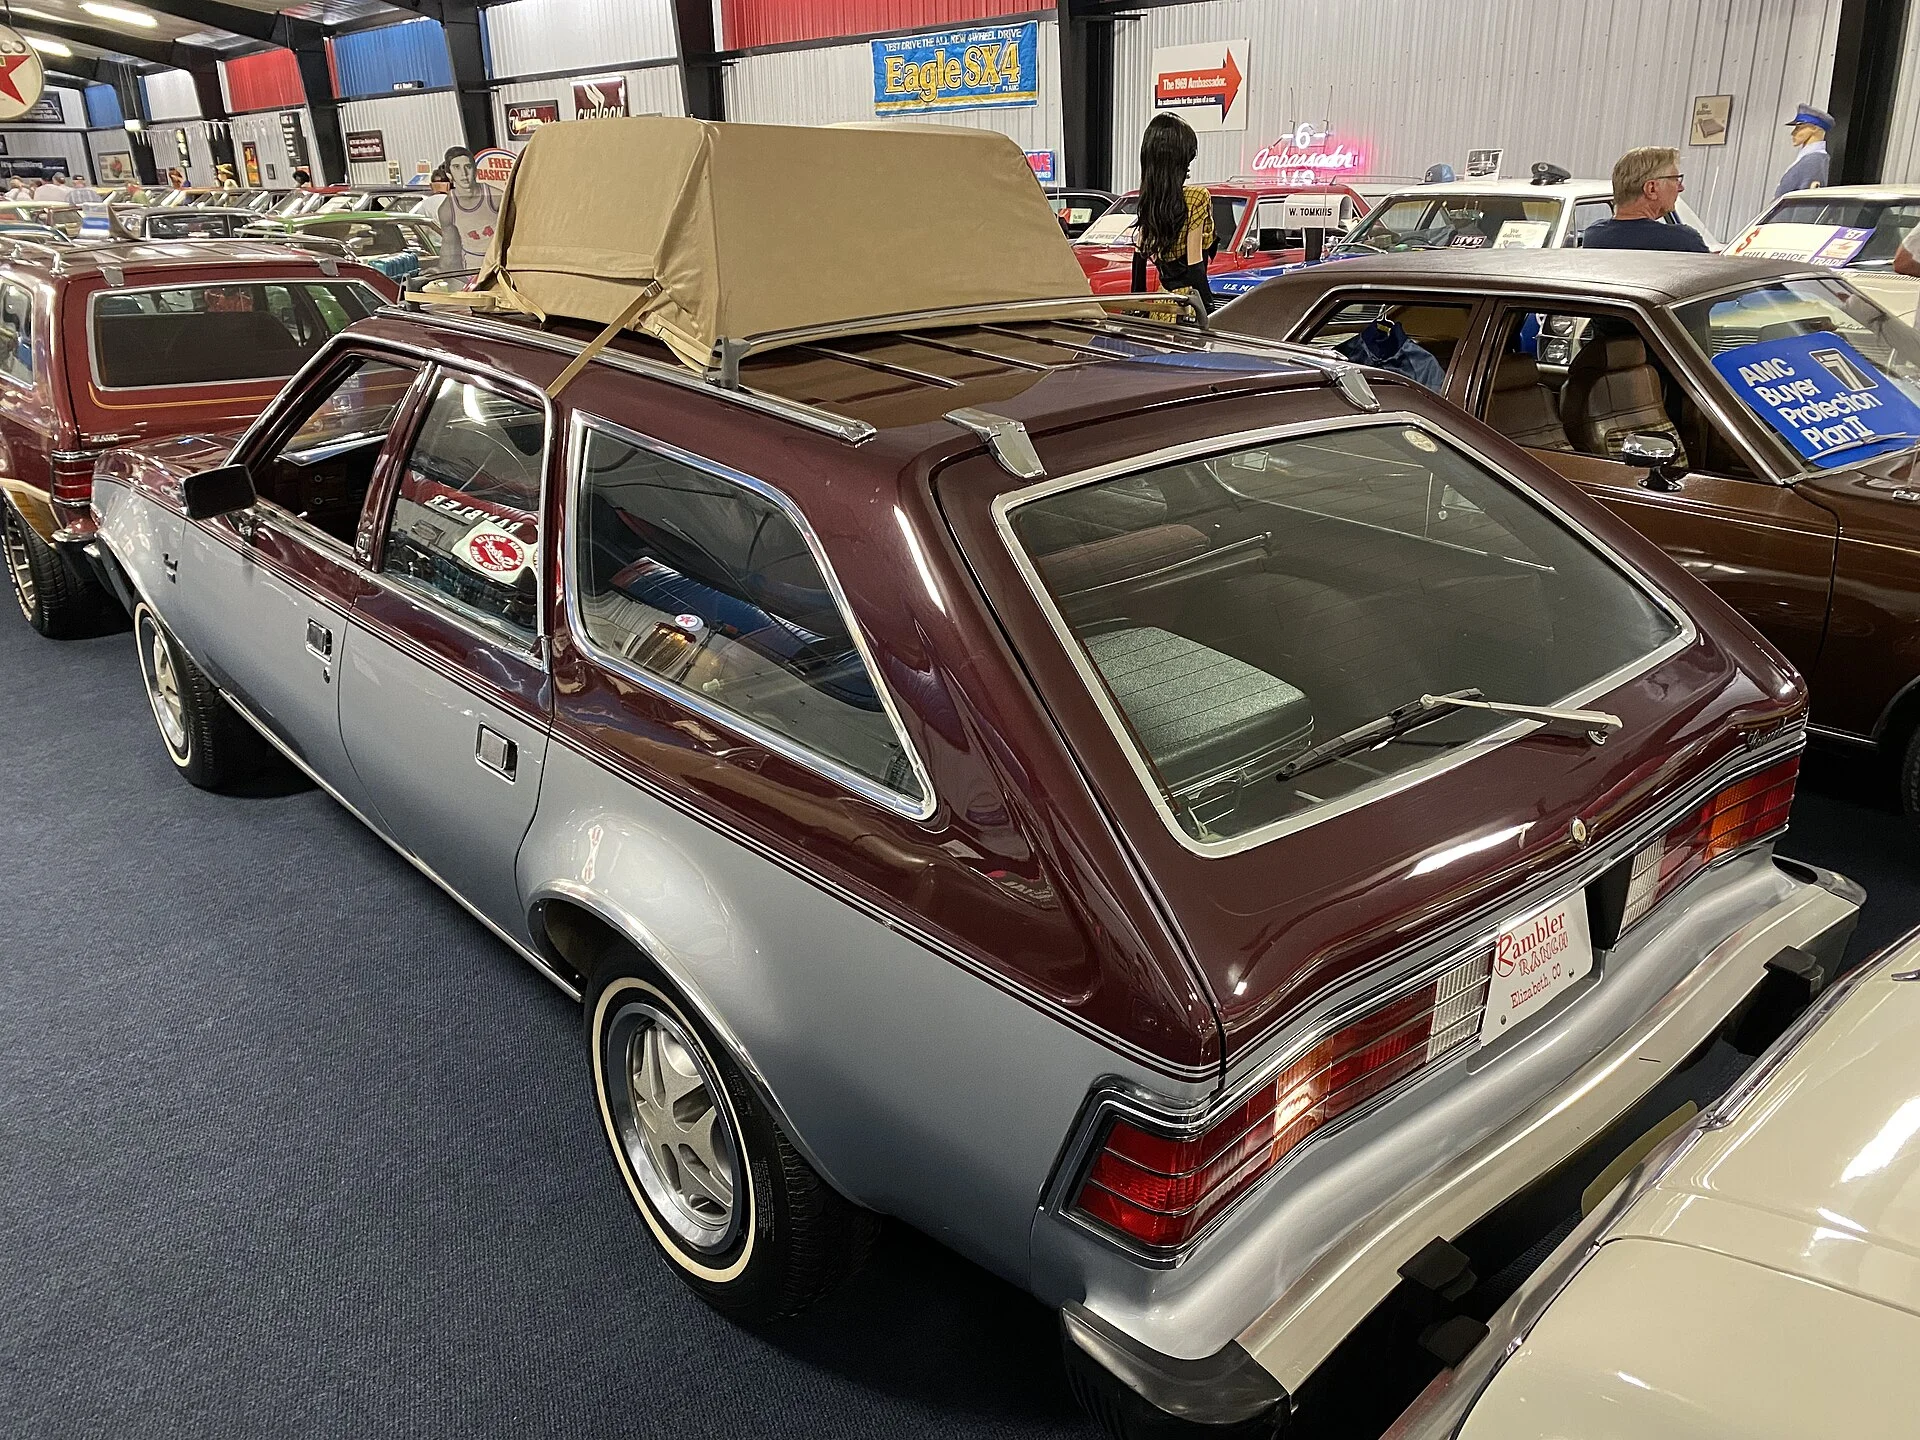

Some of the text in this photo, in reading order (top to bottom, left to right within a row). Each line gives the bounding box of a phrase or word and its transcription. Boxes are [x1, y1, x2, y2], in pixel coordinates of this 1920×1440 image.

[884, 42, 900, 51] TEST
[901, 40, 922, 50] DRIVE
[922, 38, 935, 48] THE
[935, 36, 949, 46] ALL
[950, 34, 966, 44] NEW
[997, 29, 1021, 39] DRIVE
[884, 49, 962, 102] Eagle
[1163, 79, 1174, 90] The
[1188, 75, 1226, 88] Ambassador.
[1296, 122, 1311, 149] 6
[488, 158, 512, 169] FREE
[1252, 145, 1354, 170] Ambassador
[476, 169, 510, 180] BASKET
[1289, 208, 1333, 216] W. TOMKINS
[1735, 227, 1761, 254] $
[1769, 251, 1808, 262] PRICE
[1811, 257, 1847, 267] TRADE
[1223, 283, 1238, 291] U.S.
[1738, 357, 1795, 387] AMC
[1754, 377, 1821, 407] Buyer
[1777, 391, 1883, 428] Protection
[1801, 415, 1875, 451] Plan II
[1495, 912, 1565, 974] Rambler
[1519, 931, 1568, 977] RANCH
[1510, 962, 1561, 1009] Elizabeth, CO
